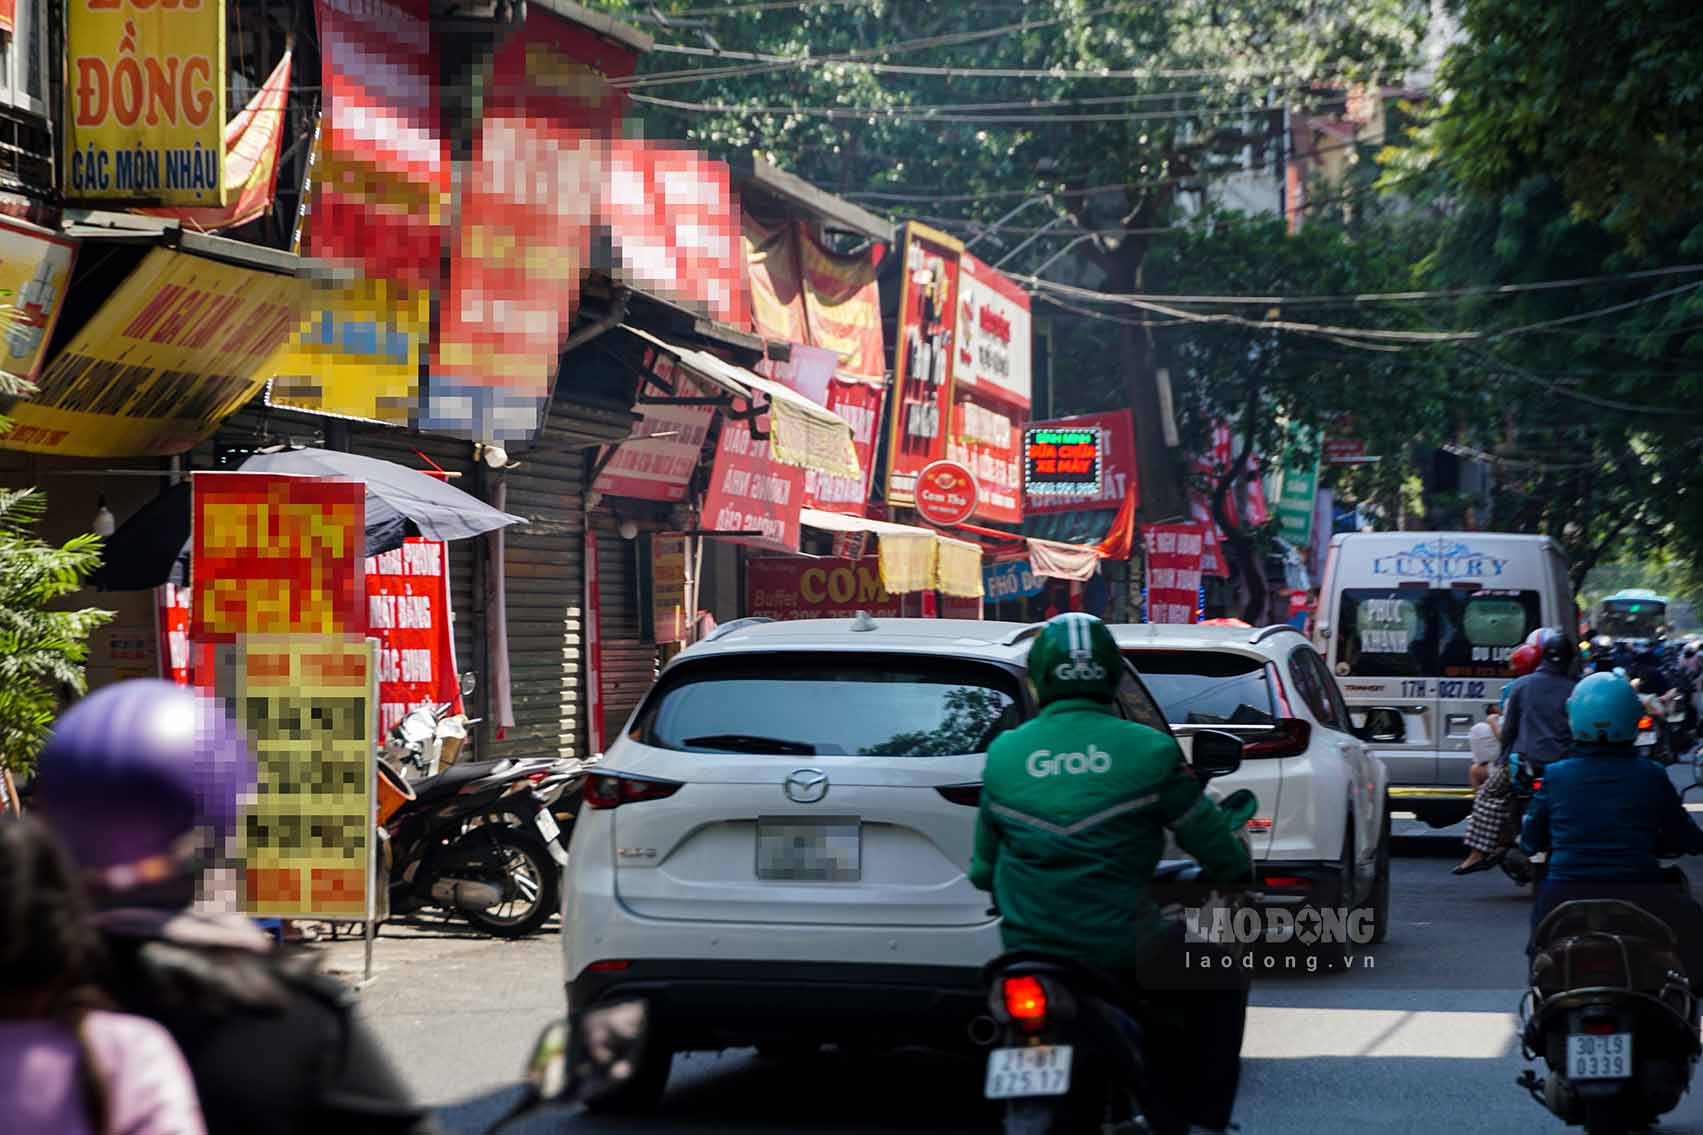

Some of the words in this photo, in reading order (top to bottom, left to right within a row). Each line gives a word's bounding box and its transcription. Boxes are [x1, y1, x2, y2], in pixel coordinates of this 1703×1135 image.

[76, 21, 215, 127] ĐỒNG
[72, 141, 110, 191] CÁC
[115, 141, 161, 191] MÓN
[166, 141, 217, 199] NHẬU
[1373, 558, 1510, 577] LUXURY
[1055, 662, 1106, 681] Grab
[1026, 744, 1112, 778] Grab
